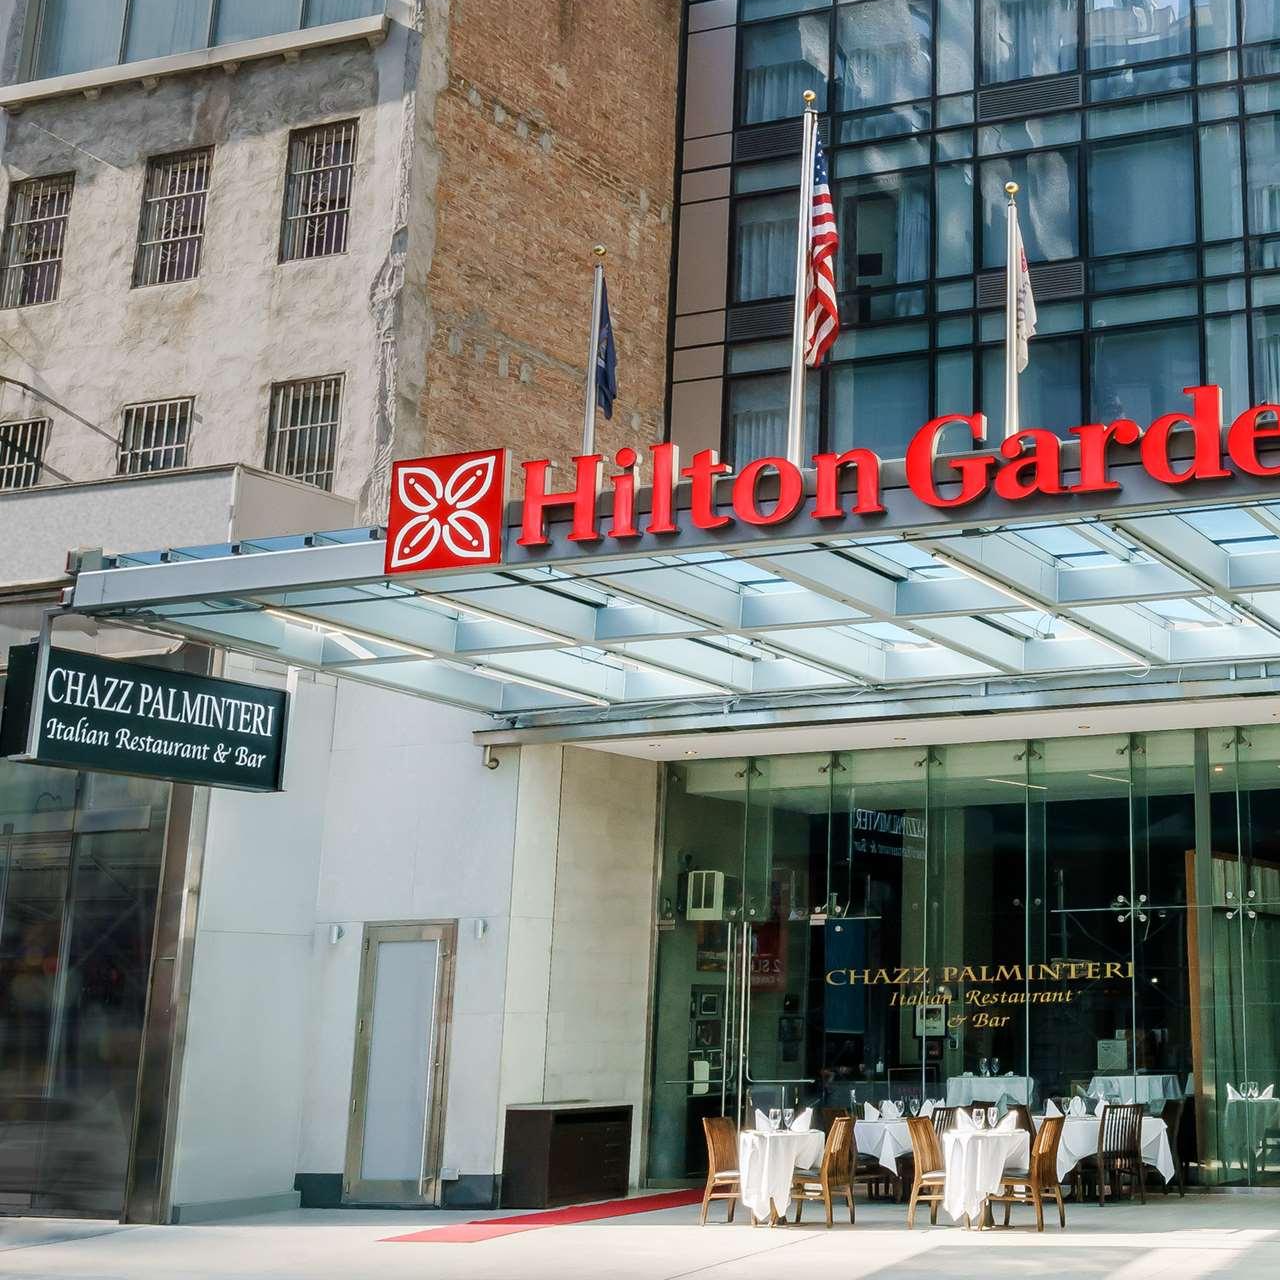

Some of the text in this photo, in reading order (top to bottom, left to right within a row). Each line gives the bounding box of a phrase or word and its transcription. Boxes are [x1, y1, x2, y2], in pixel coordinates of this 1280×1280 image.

[516, 441, 888, 548] Hilton
[48, 667, 275, 737] CHAZZ PALMINTERI
[46, 717, 267, 769] Italian Restaurant & Bar
[825, 961, 1135, 986] CHAZZ PALMINTERI
[889, 988, 1073, 1007] Italian Restaurant
[947, 1011, 1010, 1028] & Bar
